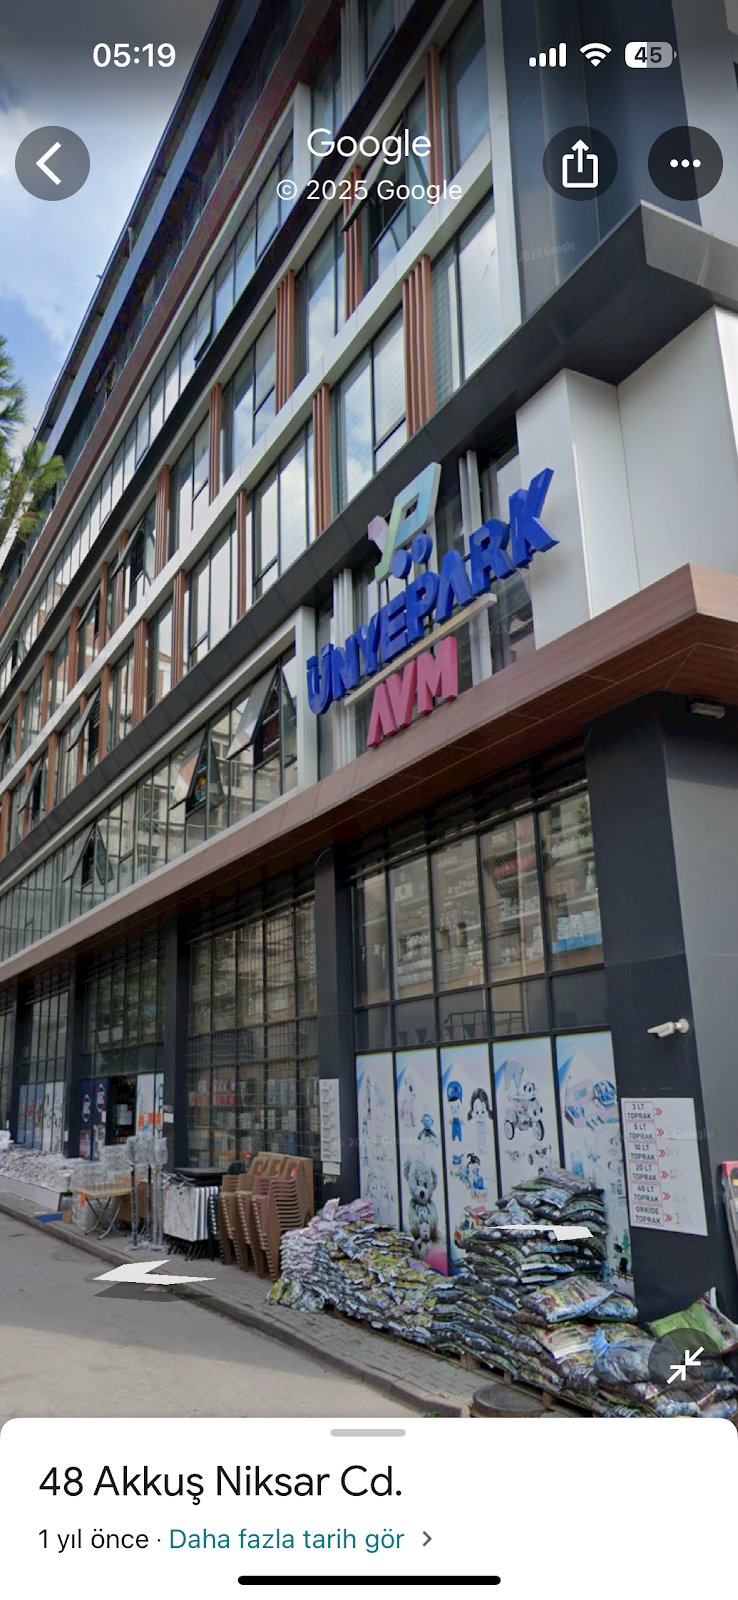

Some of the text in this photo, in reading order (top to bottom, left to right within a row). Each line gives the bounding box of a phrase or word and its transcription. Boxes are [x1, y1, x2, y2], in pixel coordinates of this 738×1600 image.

[306, 468, 560, 715] ÜNYEPARK
[366, 635, 459, 748] AVM
[629, 1132, 653, 1140] TOPRAK
[630, 1152, 655, 1161] TOPRAK
[644, 1164, 652, 1172] LT
[632, 1173, 657, 1181] TOPRAK
[634, 1194, 659, 1202] TOPRAK
[635, 1215, 661, 1225] TOPRAK
